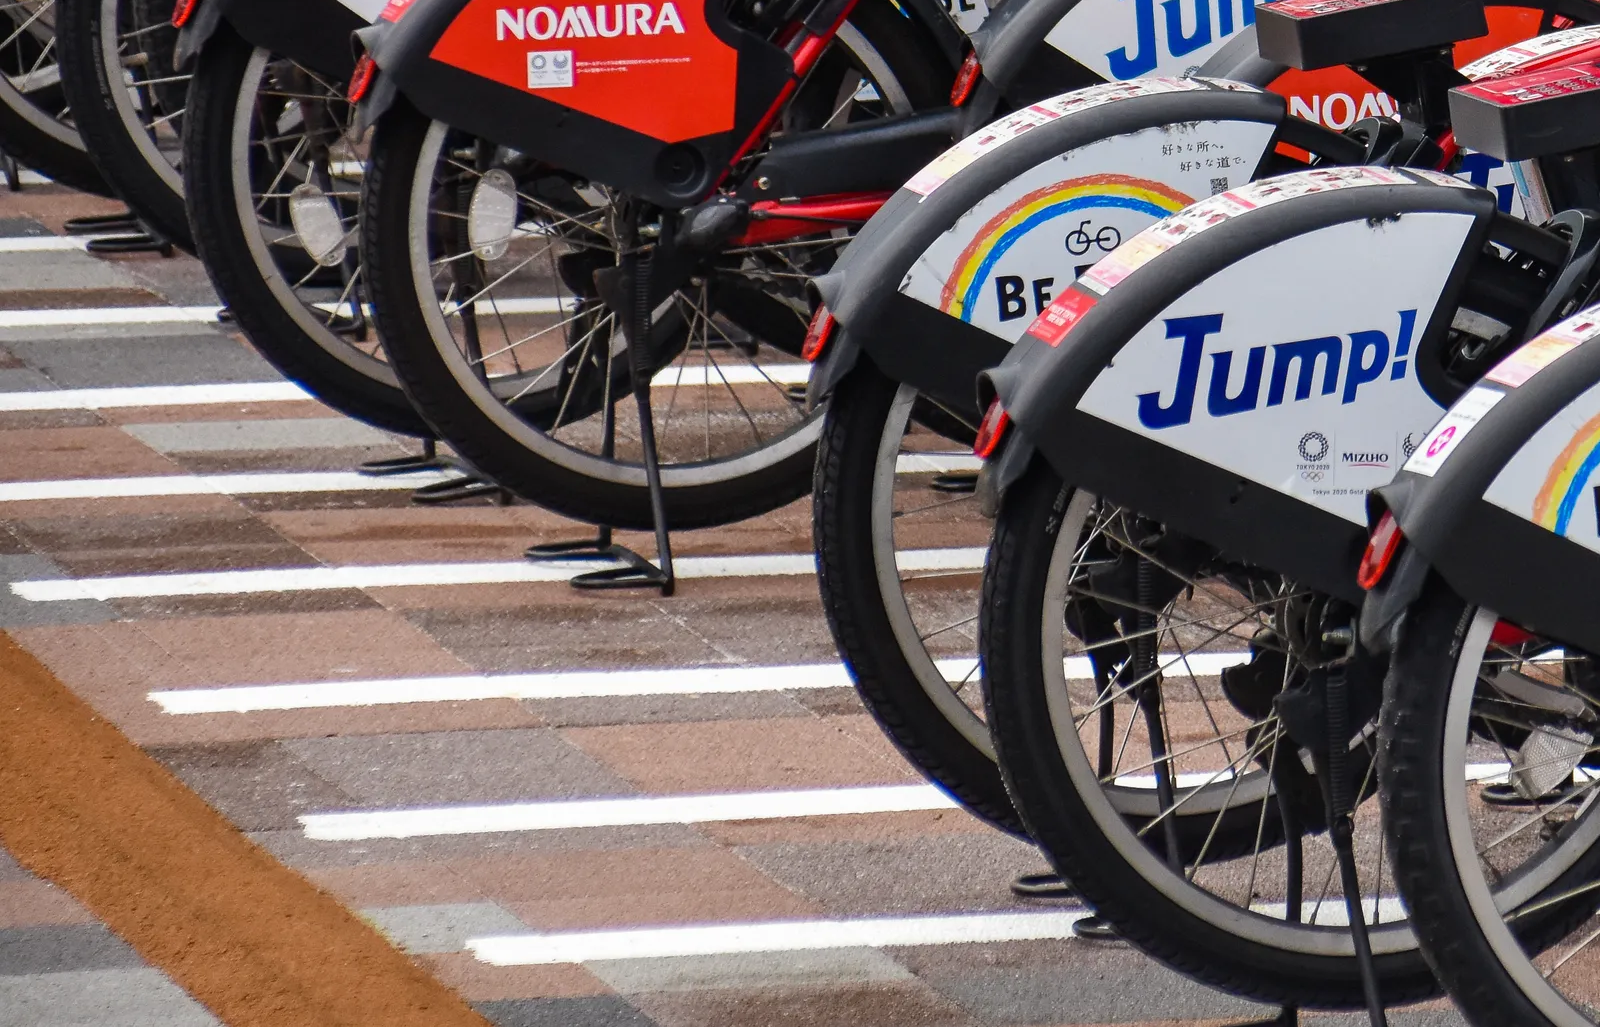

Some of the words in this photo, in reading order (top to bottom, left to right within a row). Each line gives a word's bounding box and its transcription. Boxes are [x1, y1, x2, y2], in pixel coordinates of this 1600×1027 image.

[496, 2, 685, 41] NOMURA
[1291, 93, 1402, 132] NOM
[1136, 309, 1417, 429] Jump!
[1341, 452, 1389, 463] MIZUHO
